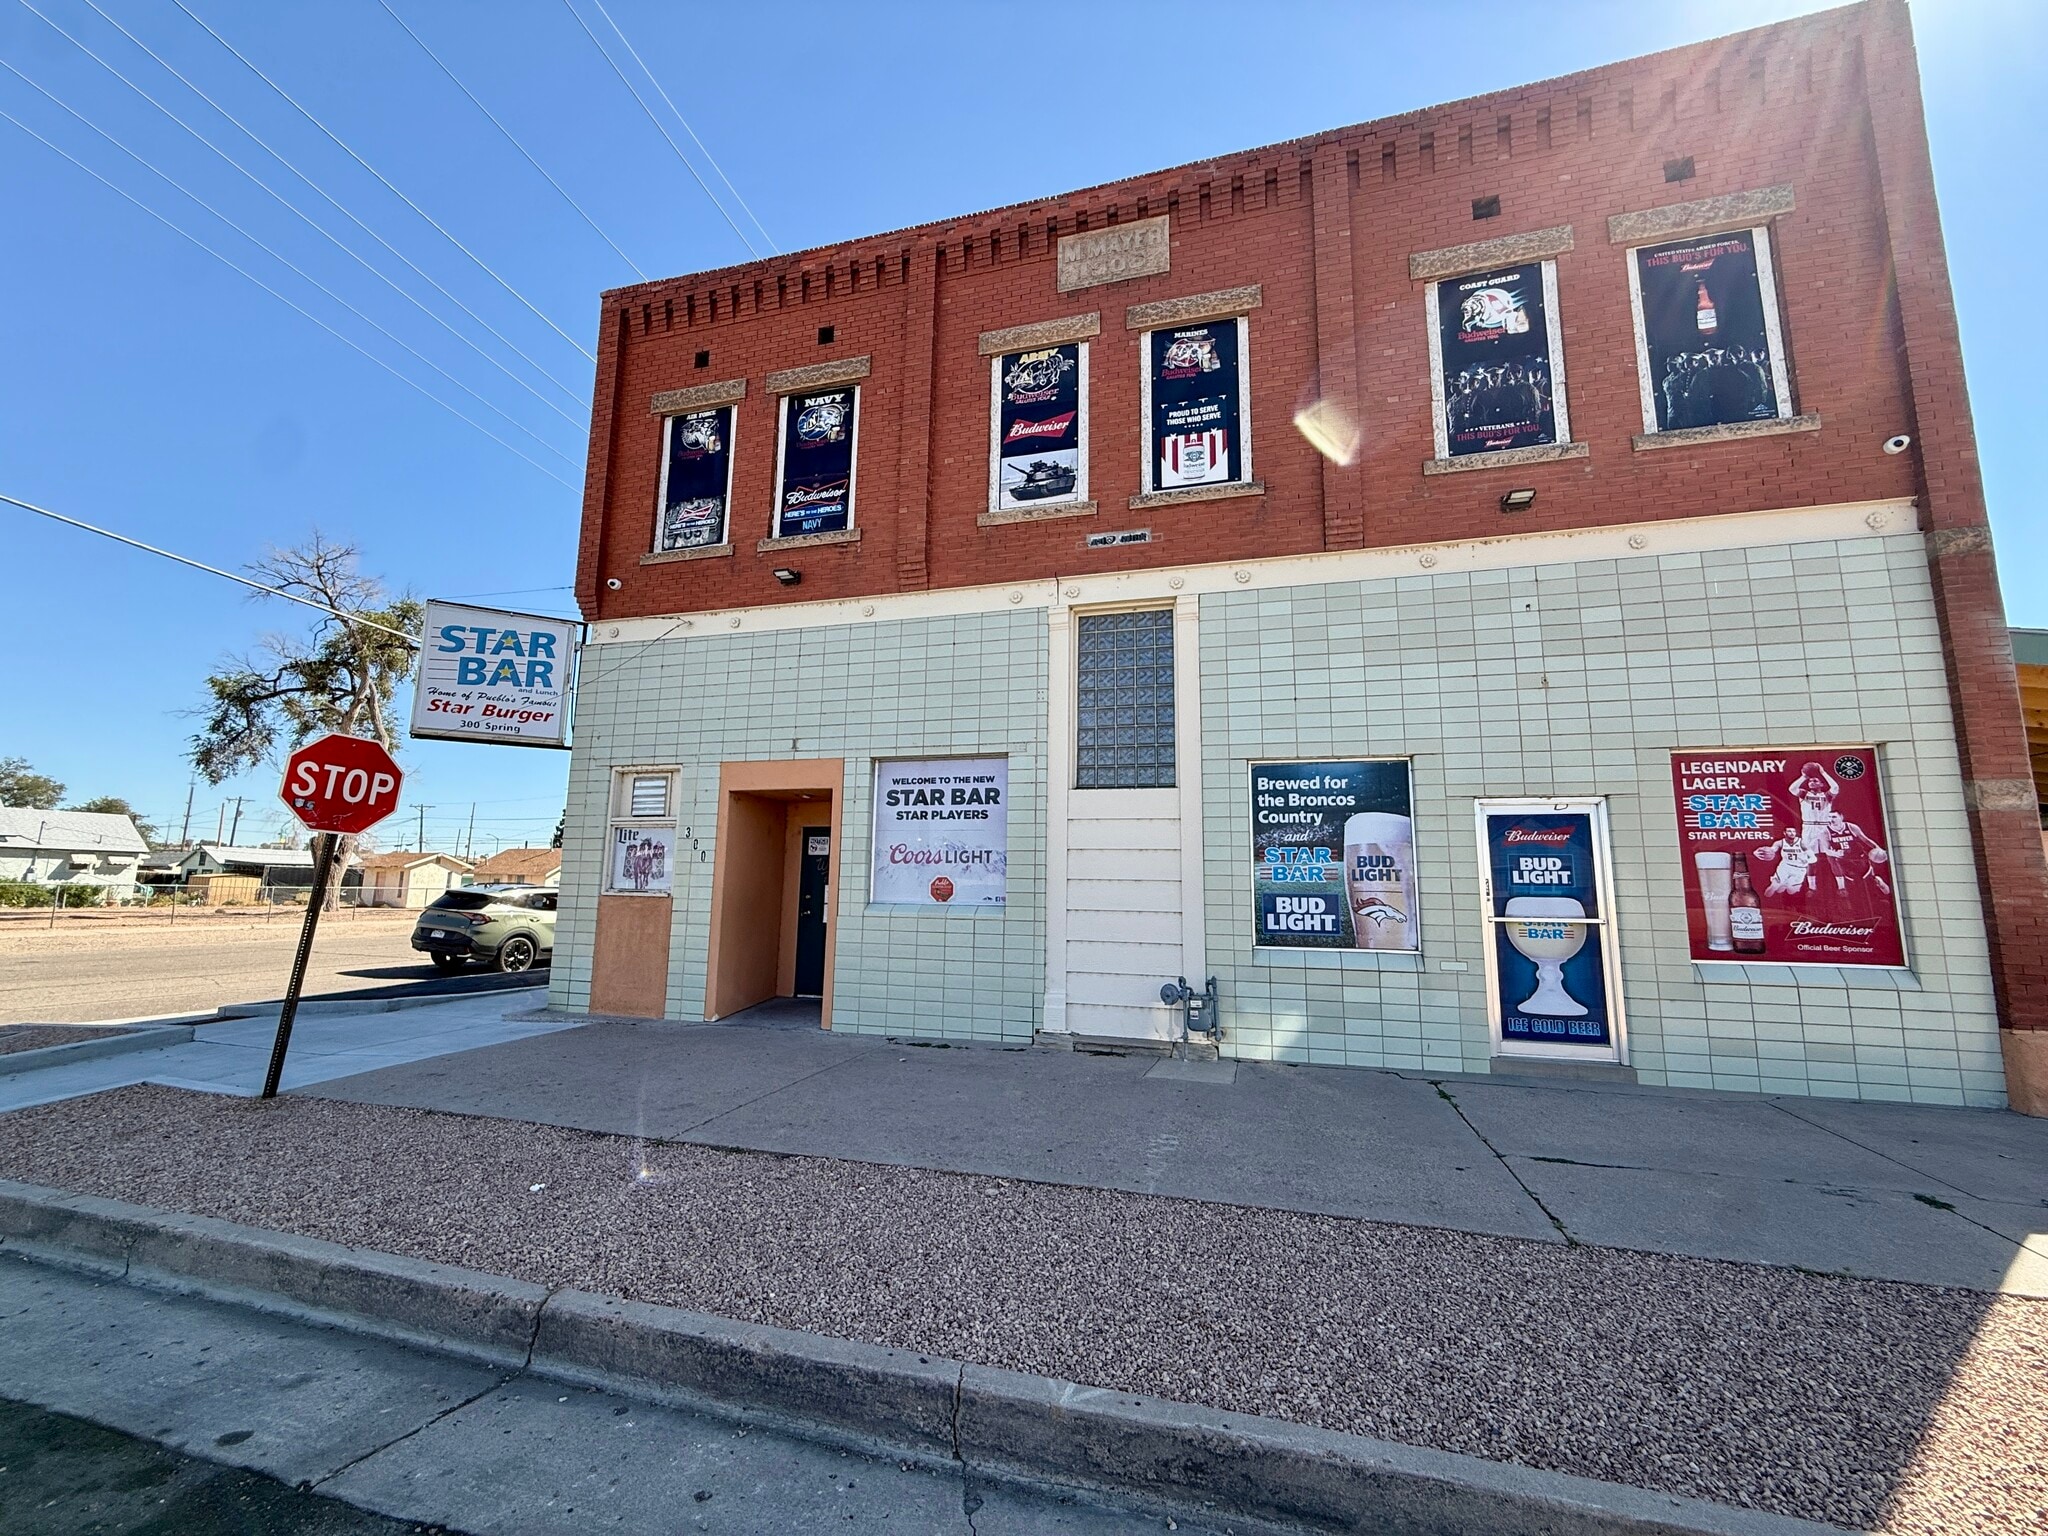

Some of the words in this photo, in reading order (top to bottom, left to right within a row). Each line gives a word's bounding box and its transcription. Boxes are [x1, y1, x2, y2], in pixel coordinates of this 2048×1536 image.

[1647, 256, 1669, 267] THIS
[1671, 252, 1701, 263] BUD'S
[1704, 247, 1724, 258] FOR
[1654, 249, 1676, 258] UNITED
[1676, 247, 1695, 255] STATES
[1696, 243, 1717, 251] ARMED
[1459, 280, 1488, 291] COAST
[1488, 274, 1520, 286] GUARD
[1019, 348, 1060, 364] ARMY
[804, 393, 845, 407] NAVY
[1166, 417, 1186, 426] THOSE
[1186, 415, 1202, 423] WHO
[1202, 411, 1221, 421] SERVE
[1169, 410, 1190, 418] PROUD
[1199, 404, 1219, 414] SERVE
[1010, 420, 1070, 437] Budweiser
[1456, 432, 1475, 441] THIS
[1477, 429, 1502, 439] BUD'S
[1503, 426, 1520, 436] FOR
[1479, 422, 1515, 431] VETERANS
[786, 489, 847, 505] Budweiser
[785, 510, 805, 518] HERE'S
[817, 504, 842, 514] HEROES
[802, 518, 822, 530] NAVY
[438, 625, 557, 659] STAR
[457, 656, 554, 688] BAR
[427, 686, 457, 698] Home
[461, 691, 473, 701] of
[477, 692, 516, 703] Pueblo's
[520, 696, 557, 708] Famous
[535, 689, 559, 697] Lunch
[427, 698, 474, 715] Star
[481, 704, 554, 724] Burger
[460, 720, 480, 729] 300
[485, 722, 521, 734] Spring
[1680, 760, 1786, 774] LEGENDARY
[291, 761, 395, 806] STOP
[892, 777, 937, 785] WELCOME
[938, 776, 951, 784] TO
[953, 776, 971, 784] THE
[973, 775, 995, 784] NEW
[1257, 776, 1320, 791] Brewed
[1324, 776, 1348, 789] for
[1682, 777, 1746, 790] LAGER.
[886, 788, 945, 806] STAR
[951, 788, 1000, 805] BAR
[1257, 794, 1285, 807] the
[1288, 793, 1356, 807] Broncos
[1689, 794, 1766, 812] STAR
[1811, 801, 1821, 811] 14
[896, 810, 928, 820] STAR
[931, 809, 989, 820] PLAYERS
[1258, 810, 1323, 826] Country
[1698, 812, 1760, 829] BAR
[618, 828, 640, 845] Lite
[1284, 831, 1310, 842] and
[1505, 829, 1570, 843] Budweiser
[1688, 831, 1716, 840] STAR
[1720, 831, 1773, 840] PLAYERS.
[1840, 842, 1850, 850] 15
[890, 843, 943, 865] Coors
[945, 850, 992, 864] LIGHT
[1264, 847, 1332, 865] STAR
[1357, 855, 1395, 868] BUD
[1787, 853, 1798, 861] 27
[1519, 857, 1562, 871] BUD
[1272, 865, 1326, 883] BAR
[1352, 869, 1402, 882] LIGHT
[1512, 870, 1571, 884] LIGHT
[1275, 897, 1326, 914] BUD
[1266, 914, 1335, 931] LIGHT
[1790, 921, 1874, 936] Budweiser
[1527, 928, 1565, 939] BAR
[1842, 945, 1874, 953] Sponsor
[1508, 1018, 1529, 1032] ICE
[1531, 1018, 1565, 1034] COLD
[1568, 1020, 1600, 1036] BEER
